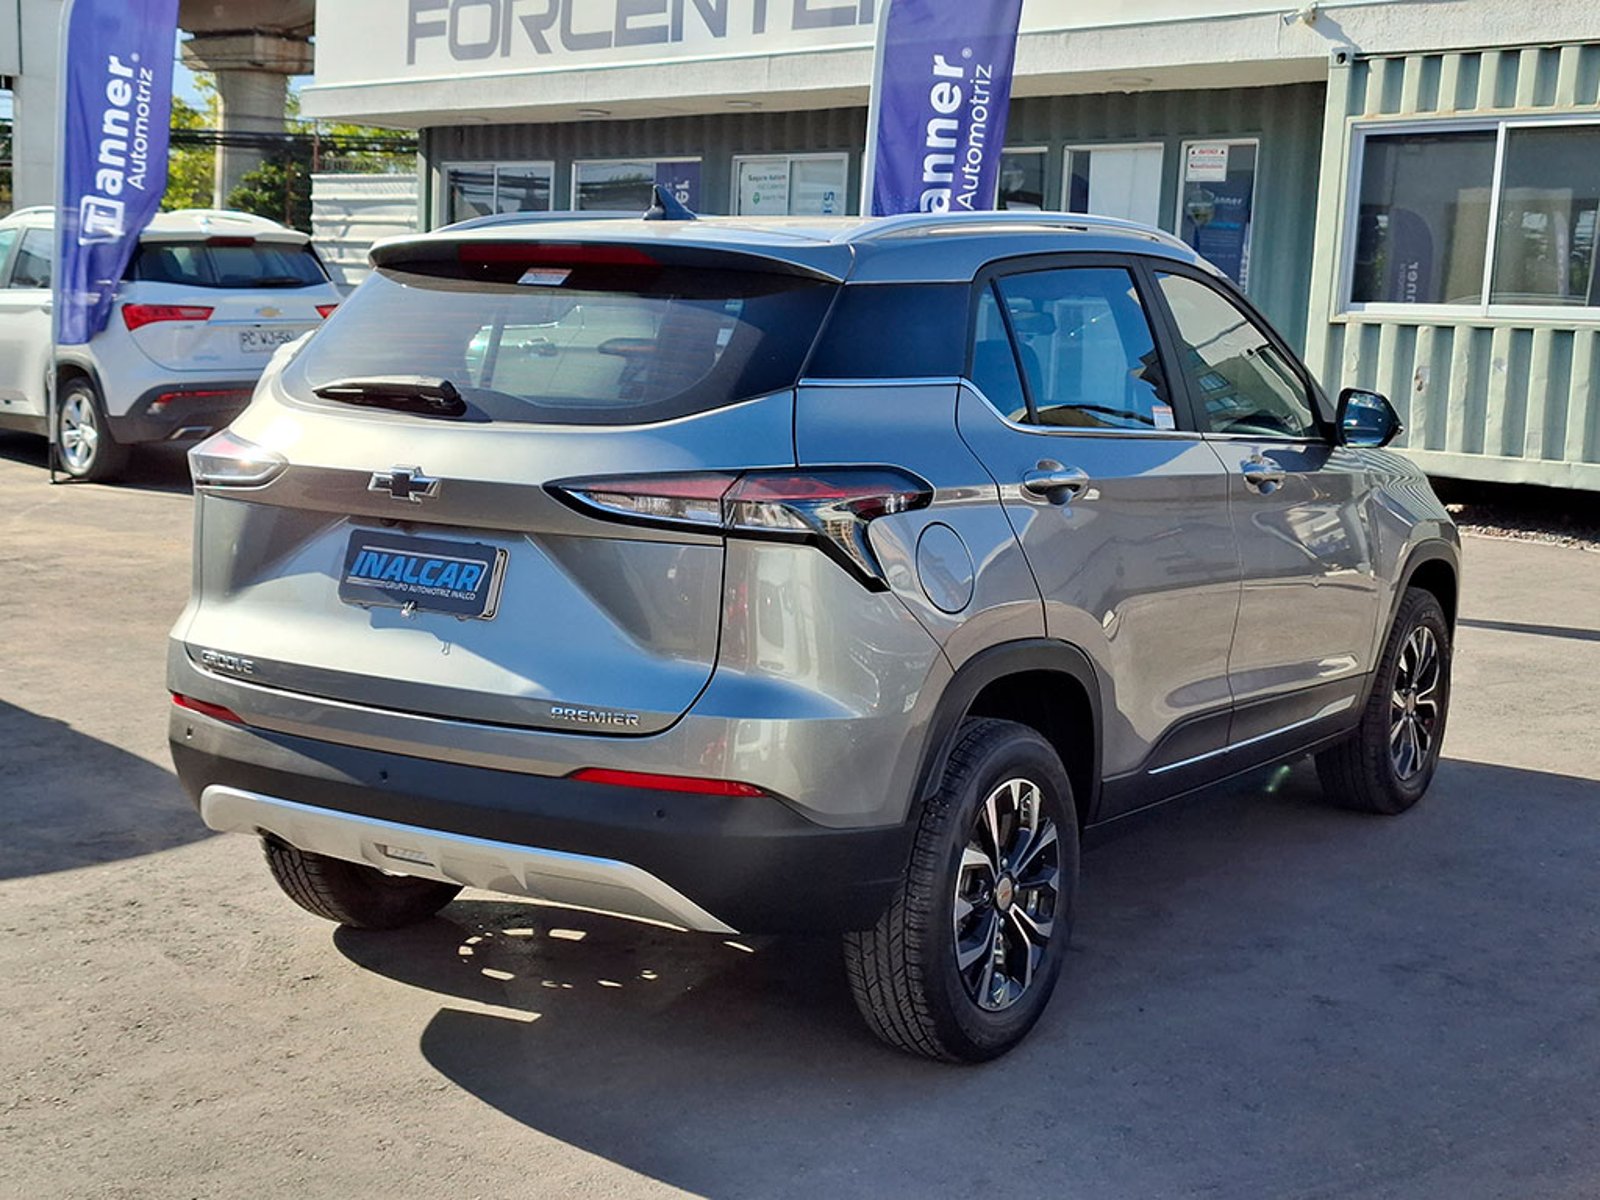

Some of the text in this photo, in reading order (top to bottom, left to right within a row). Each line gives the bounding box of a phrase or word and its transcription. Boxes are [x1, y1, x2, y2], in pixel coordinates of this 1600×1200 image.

[127, 66, 154, 191] Automotriz
[955, 63, 993, 211] Automotriz
[350, 550, 482, 591] INALCAR
[384, 580, 476, 601] GRUPO AUTOMOTRIZ INALCO
[550, 706, 640, 727] PREMIER
